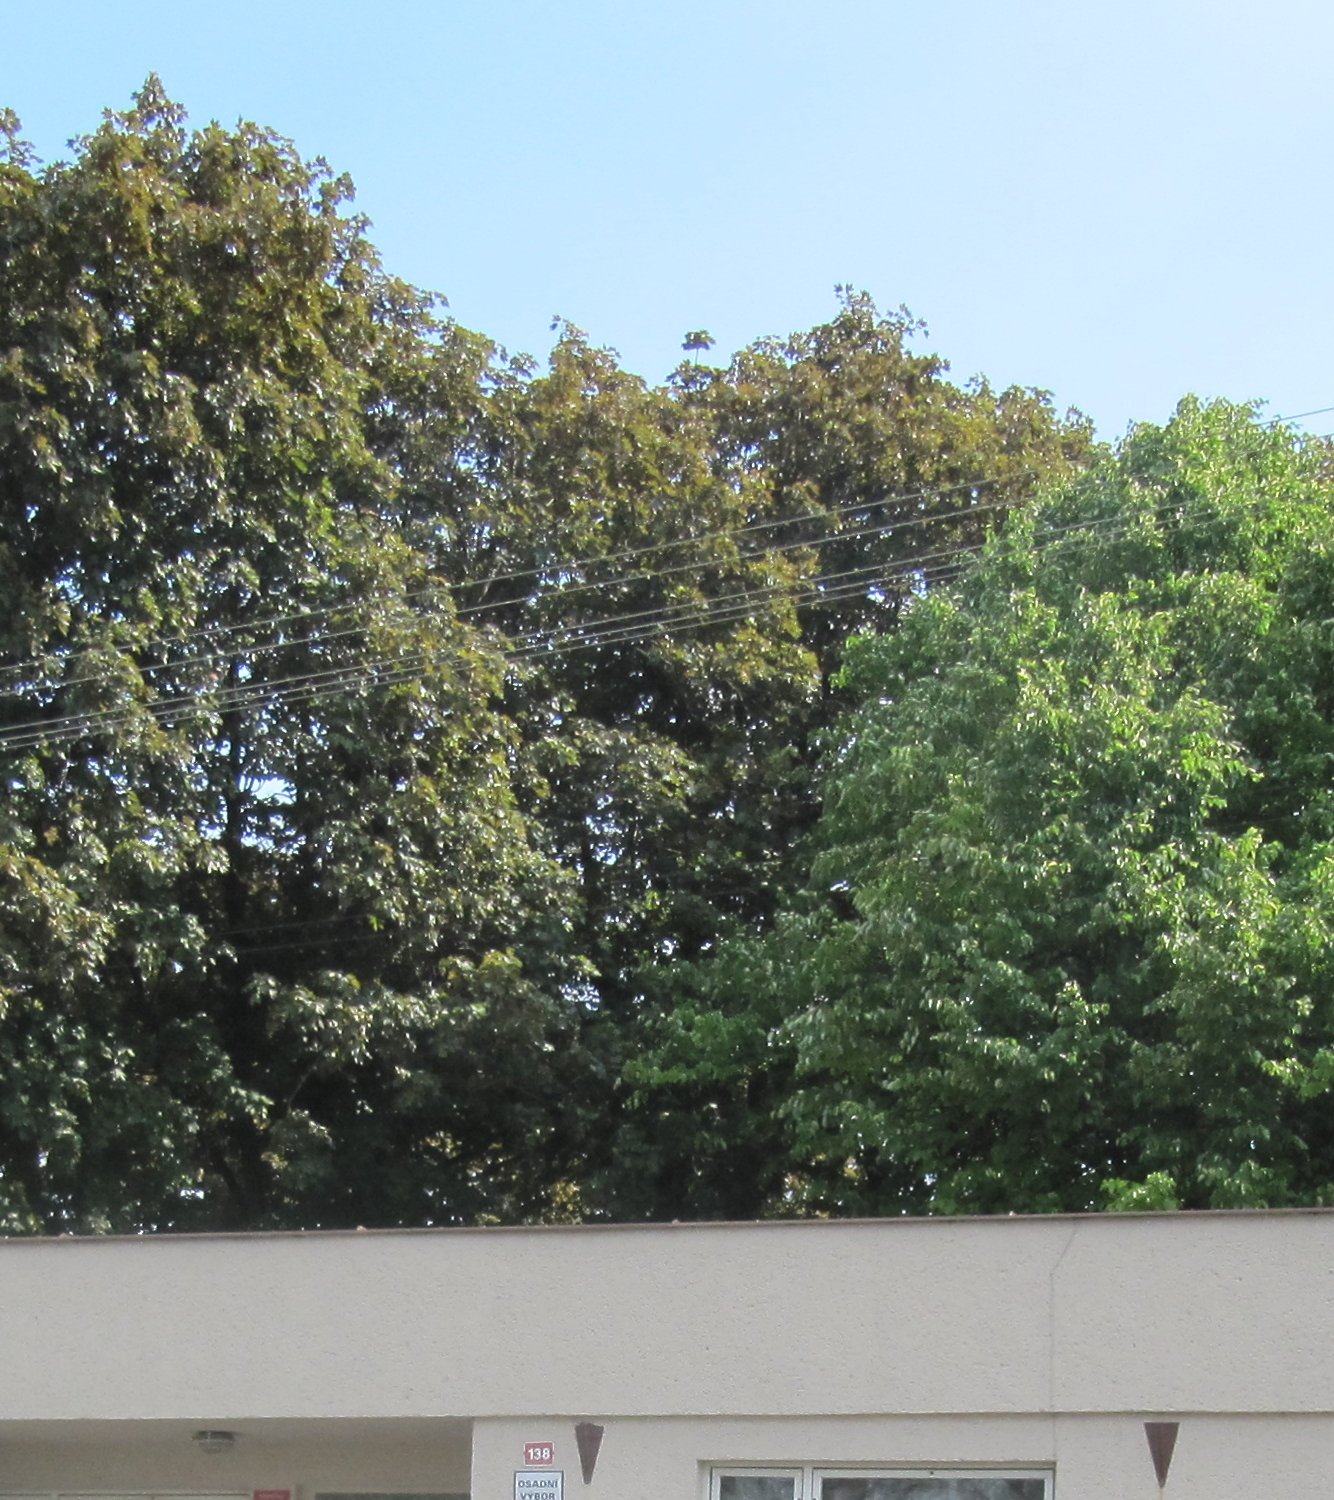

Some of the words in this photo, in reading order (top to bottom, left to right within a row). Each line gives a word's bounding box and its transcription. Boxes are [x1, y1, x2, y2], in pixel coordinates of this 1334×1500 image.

[528, 1447, 551, 1460] 138
[518, 1479, 558, 1488] OSADNÍ
[520, 1491, 555, 1500] VÝBOR
